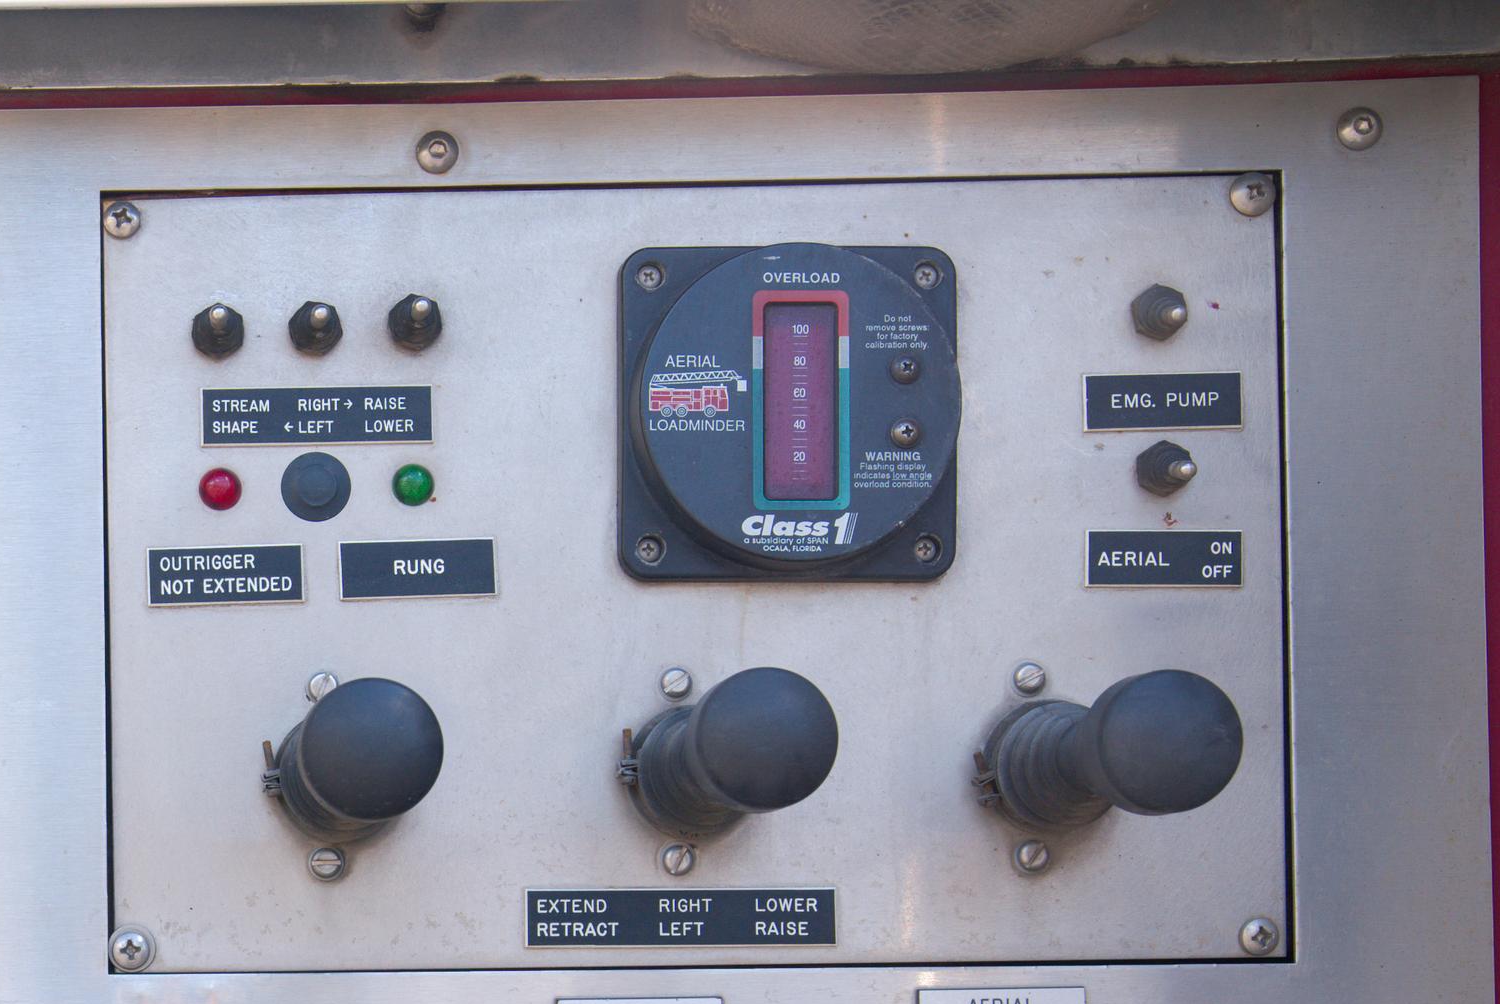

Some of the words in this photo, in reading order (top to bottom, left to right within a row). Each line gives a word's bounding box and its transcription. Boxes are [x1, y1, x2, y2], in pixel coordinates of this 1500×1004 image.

[763, 272, 840, 284] OVERLOAD
[792, 324, 809, 334] 100
[664, 355, 720, 368] AERIAL
[211, 399, 271, 413] STREAM
[297, 398, 340, 412] RIGHT
[364, 397, 407, 411] RAISE
[1111, 393, 1156, 408] EMG.
[1166, 392, 1219, 407] PUMP
[211, 420, 259, 435] SHAPE
[298, 420, 334, 435] LEFT
[364, 419, 414, 433] LOWER
[649, 419, 745, 432] LOADMINDER
[793, 452, 806, 462] 20
[865, 452, 920, 461] WARNING
[860, 463, 895, 471] Flashing
[897, 463, 926, 471] display
[909, 472, 932, 480] angle
[752, 537, 794, 545] subsidiary
[1211, 542, 1232, 554] ON
[159, 554, 256, 572] OUTRIGGER
[1098, 551, 1170, 566] AERIAL
[393, 559, 445, 576] RUNG
[1202, 565, 1233, 578] OFF
[160, 579, 194, 596] NOT
[202, 576, 293, 595] EXTENDED
[537, 899, 607, 913] EXTEND
[659, 899, 712, 913] RIGHT
[755, 899, 818, 912] LOWER
[537, 922, 618, 936] RETRACT
[659, 922, 703, 936] LEFT
[755, 922, 809, 935] RAISE
